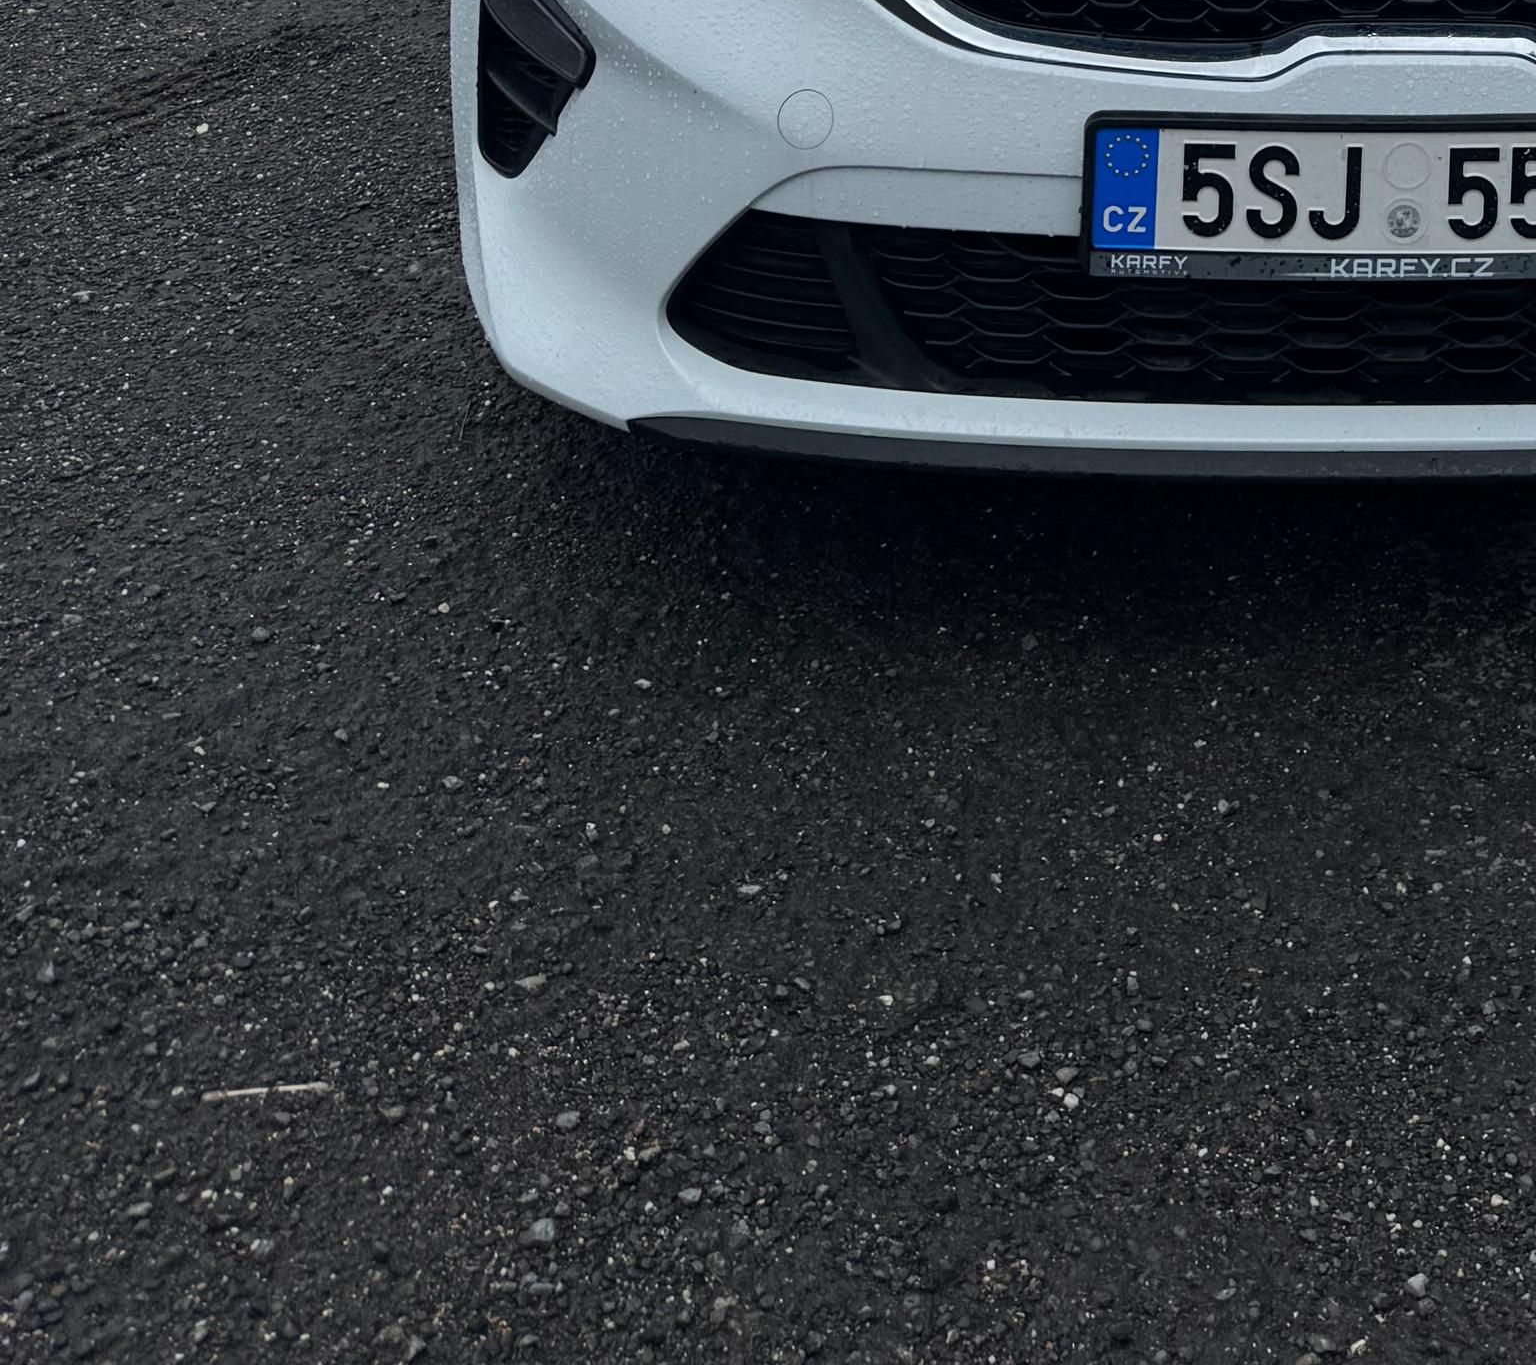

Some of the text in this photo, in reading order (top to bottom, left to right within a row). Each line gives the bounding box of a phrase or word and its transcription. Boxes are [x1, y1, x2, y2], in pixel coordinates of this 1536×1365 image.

[1180, 142, 1364, 241] 5SJ
[1102, 205, 1148, 233] CZ
[1110, 254, 1188, 270] KARFY
[1330, 257, 1495, 278] KARFY.CZ
